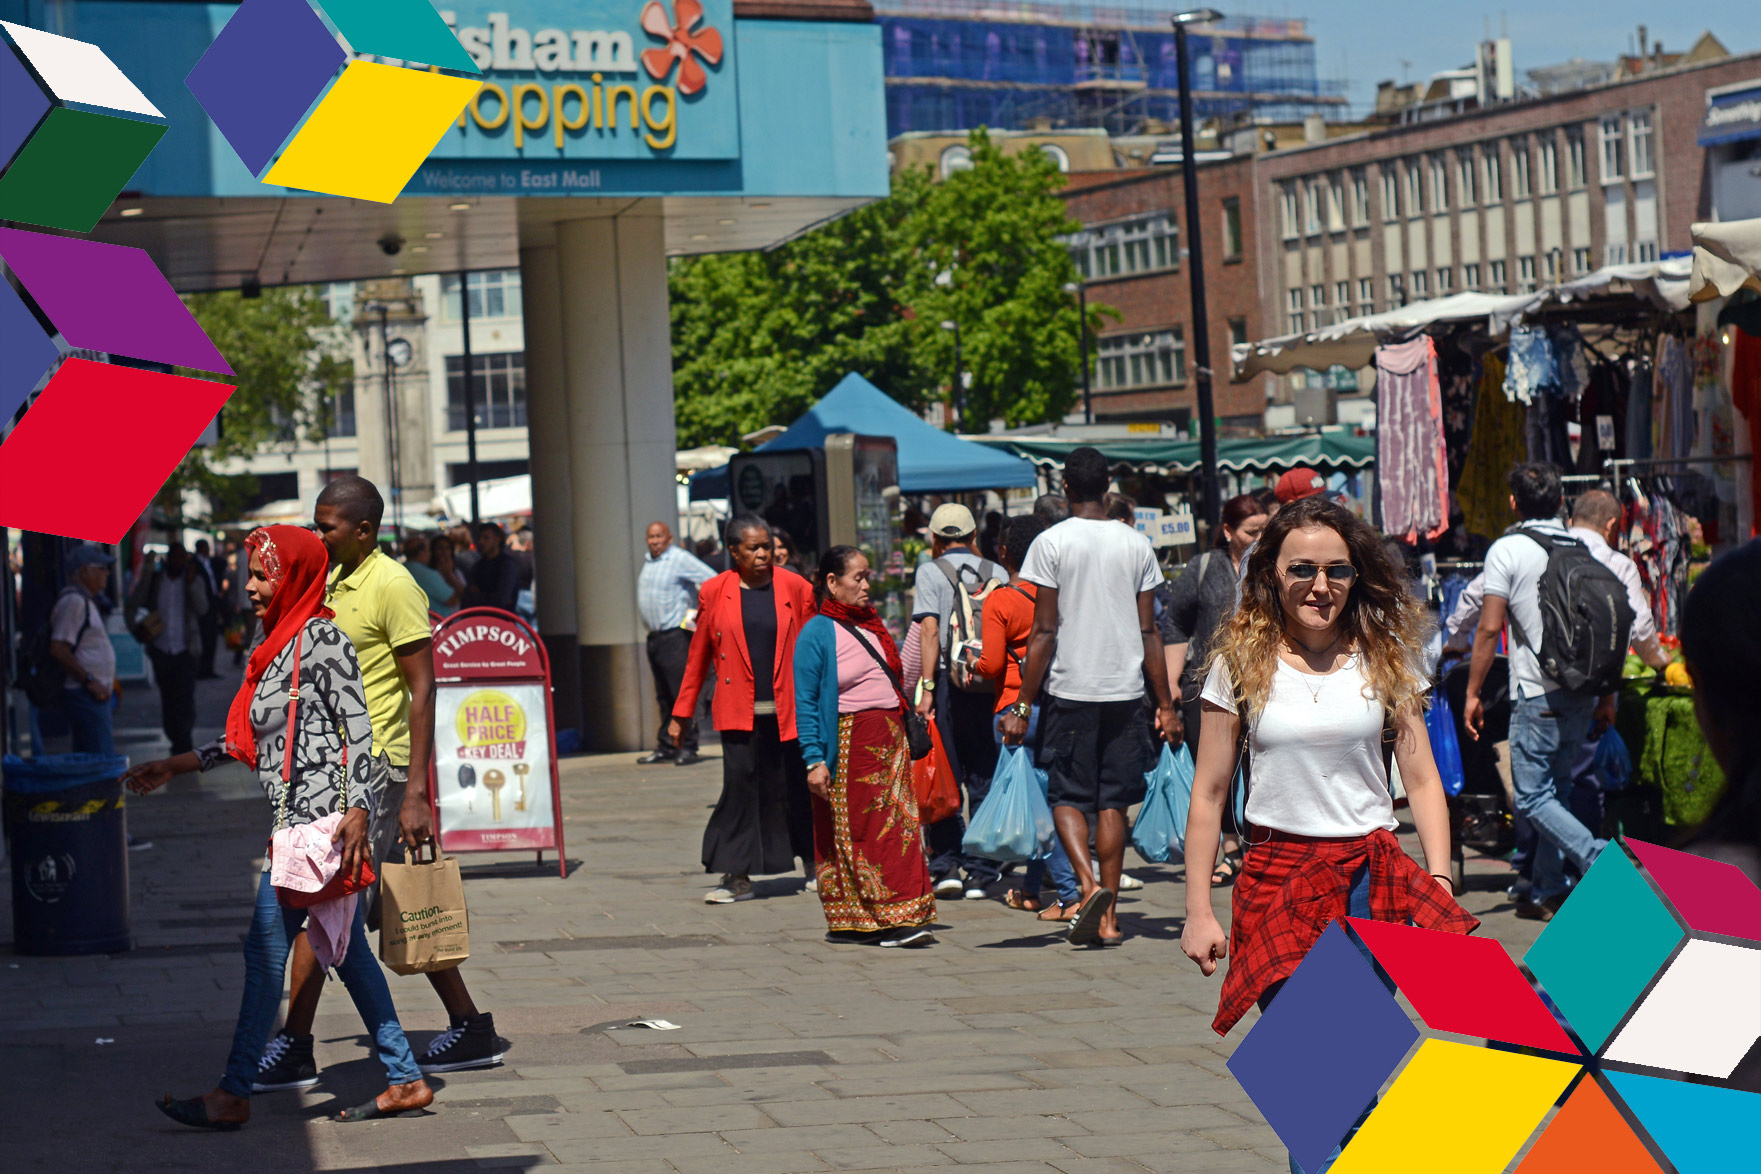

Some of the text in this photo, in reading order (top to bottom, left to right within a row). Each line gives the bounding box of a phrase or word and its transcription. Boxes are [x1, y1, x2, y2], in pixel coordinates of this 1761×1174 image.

[457, 73, 677, 149] opping
[423, 170, 600, 189] Welcome to East Mall
[1161, 521, 1190, 535] £5.00
[436, 625, 531, 657] TIMPSON
[465, 705, 515, 724] HALF
[466, 724, 516, 741] PRICE
[465, 742, 519, 759] KEY DEAL
[400, 905, 444, 923] Caution.
[400, 925, 419, 933] could
[421, 920, 438, 929] burst
[439, 915, 453, 923] into
[417, 932, 431, 940] any
[432, 922, 462, 935] moment!
